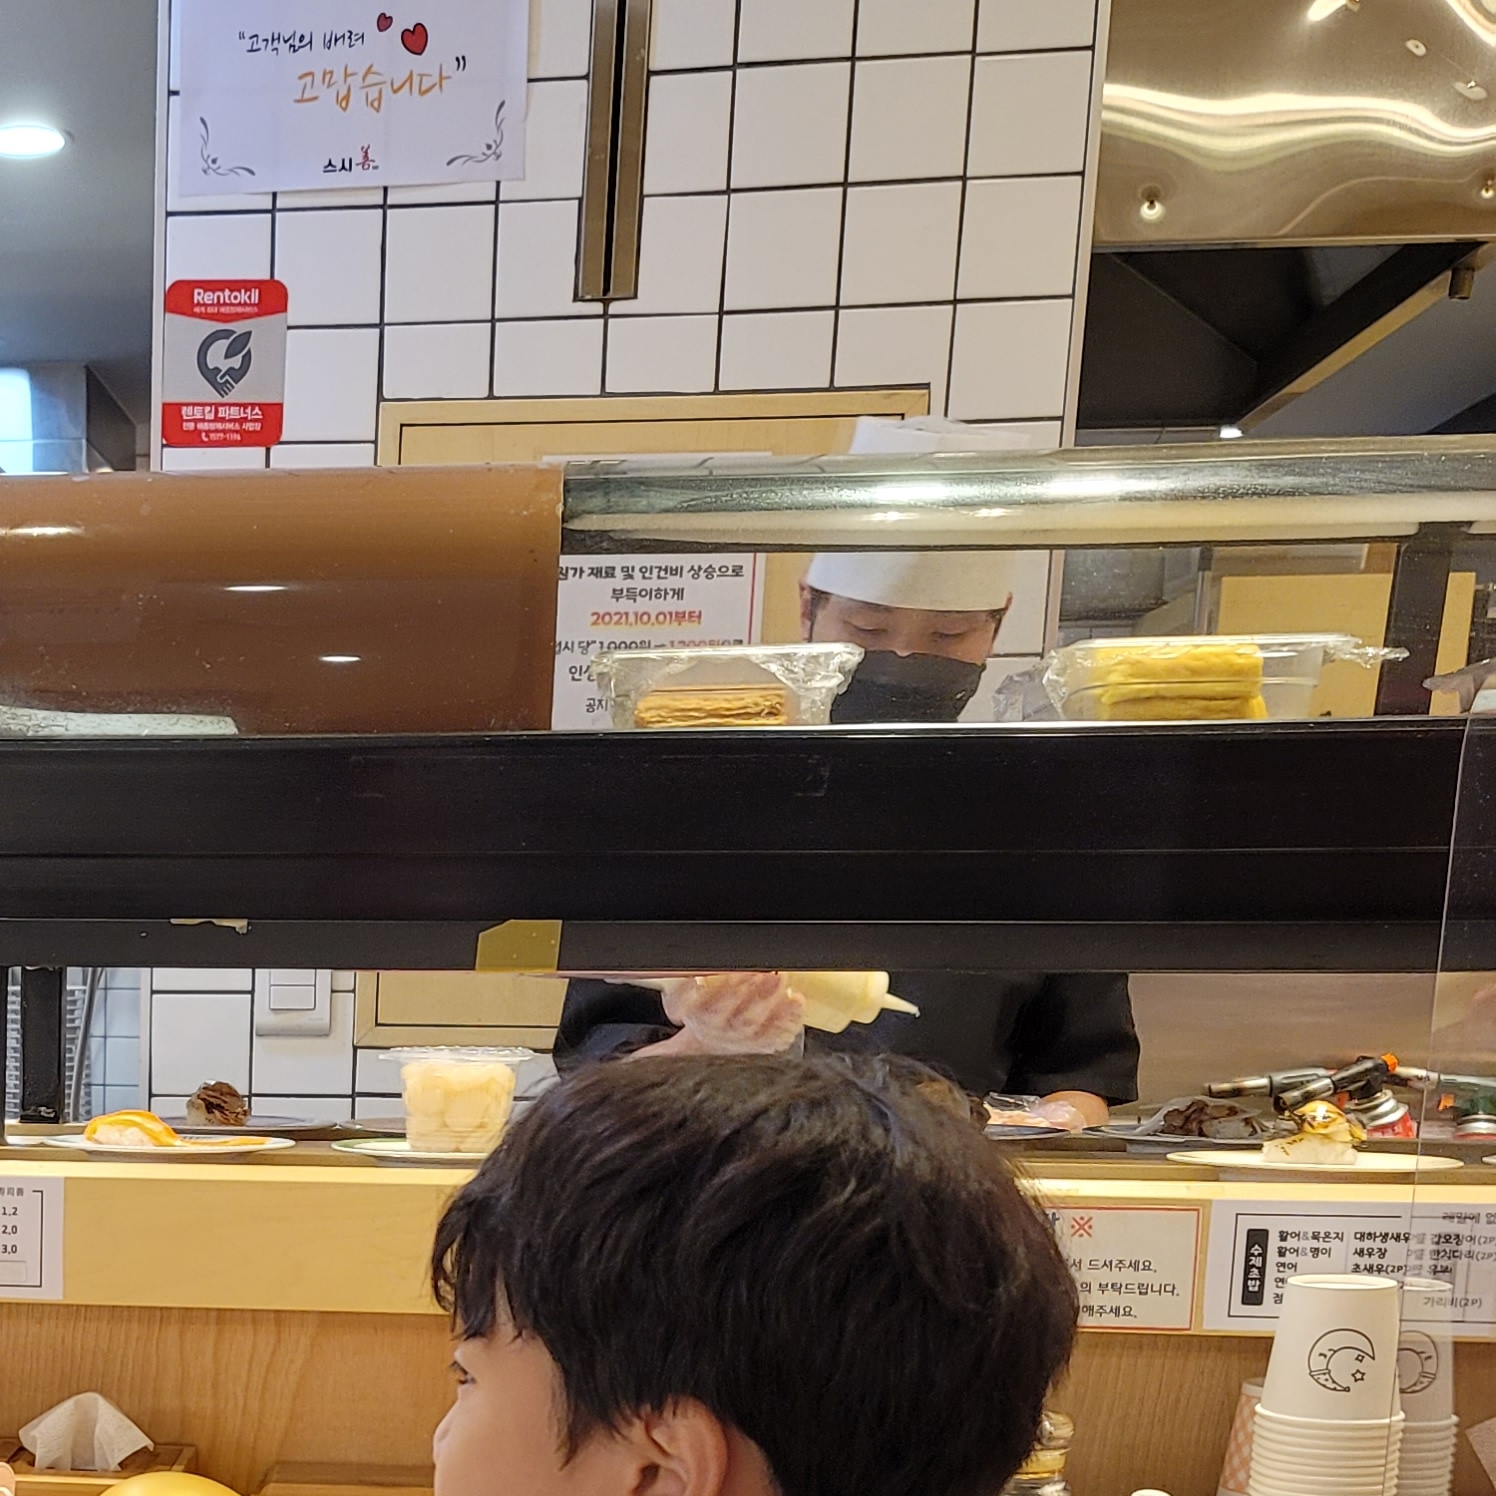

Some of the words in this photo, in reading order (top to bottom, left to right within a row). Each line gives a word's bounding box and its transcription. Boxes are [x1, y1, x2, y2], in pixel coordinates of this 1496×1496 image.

[323, 30, 365, 50] 배려
[193, 288, 260, 304] Rentokil
[217, 405, 263, 420] 파트너스
[587, 566, 616, 578] 재료
[620, 566, 635, 580] 및
[639, 565, 684, 579] 인건비
[687, 564, 744, 580] 상승으로
[611, 587, 685, 603] 부득이하게
[590, 610, 702, 627] 2021.10.01부터
[1354, 1231, 1410, 1244] 대하생새우
[1277, 1246, 1332, 1258] 활어&명이
[1353, 1247, 1387, 1259] 새우장
[1247, 1243, 1263, 1292] 수제초밥
[1275, 1262, 1298, 1273] 연어
[1097, 1282, 1180, 1297] 부탁드립니다.
